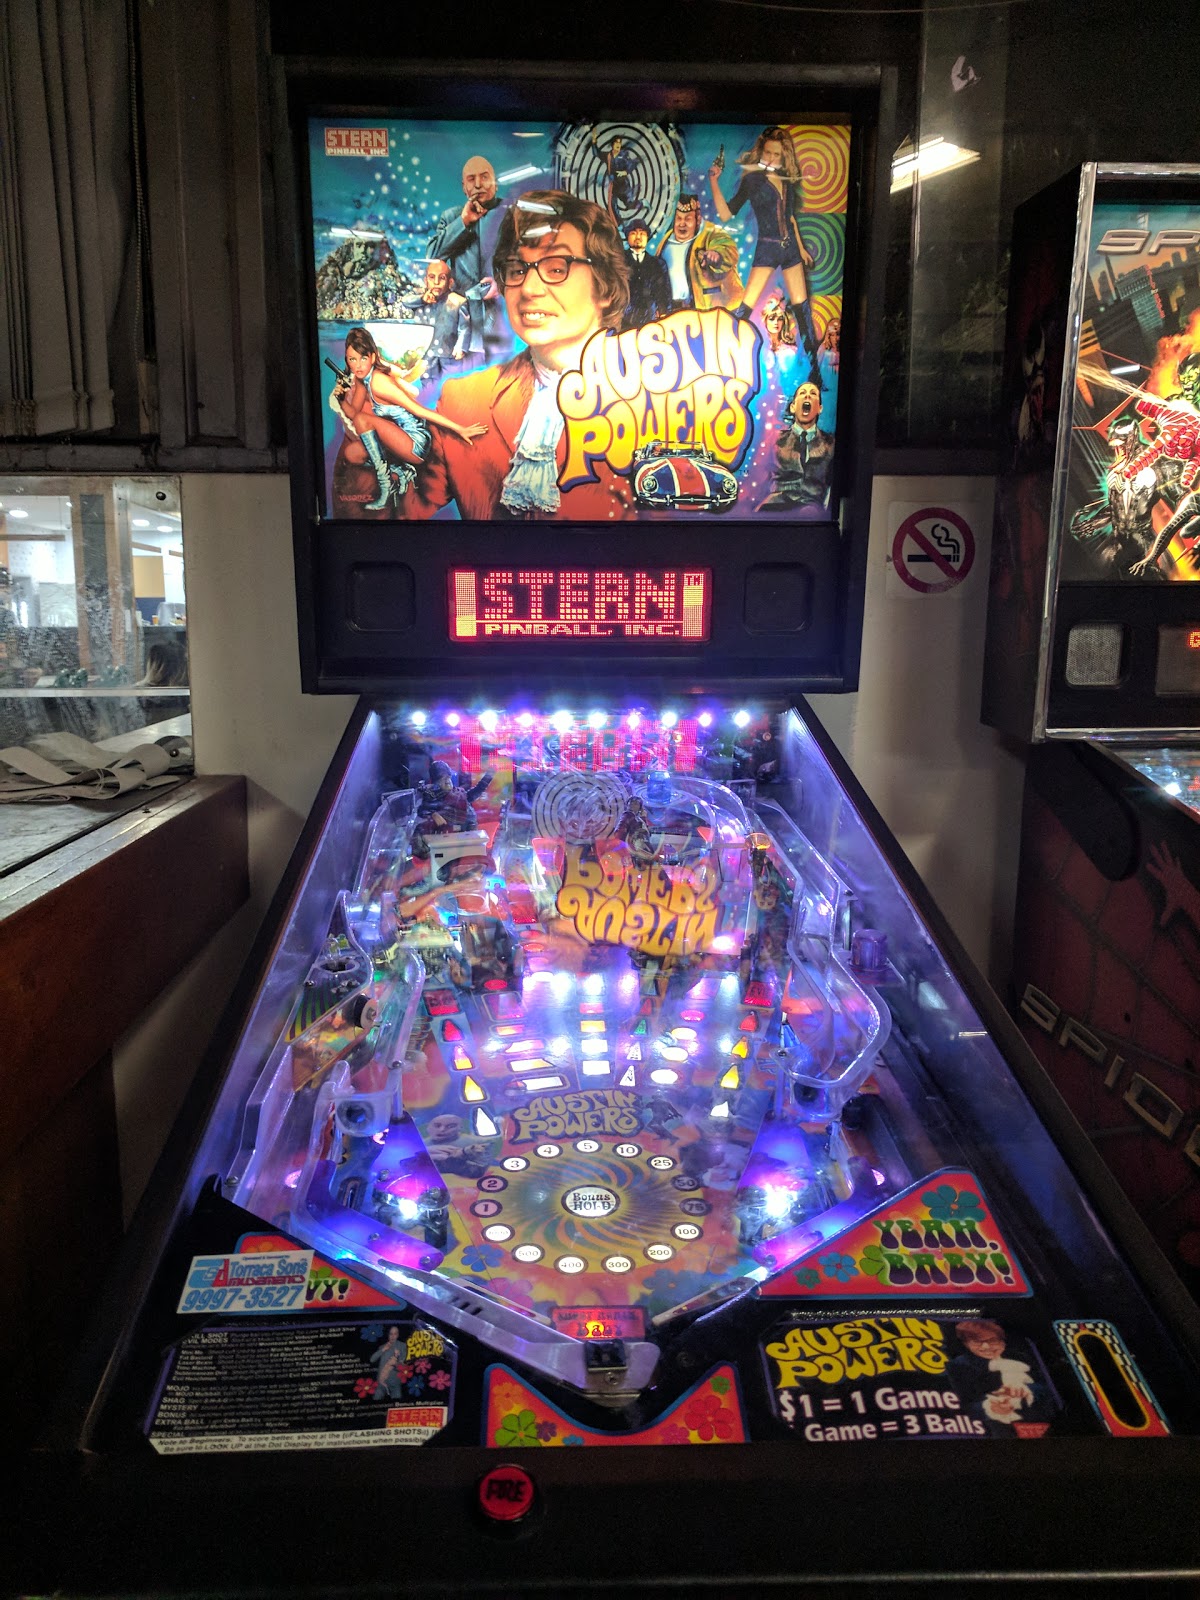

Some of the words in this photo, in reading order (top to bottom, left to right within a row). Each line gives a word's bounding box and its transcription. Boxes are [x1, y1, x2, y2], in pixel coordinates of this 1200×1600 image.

[326, 129, 387, 147] STERN
[557, 308, 758, 421] AUSTIN
[557, 374, 751, 488] POWERS
[484, 572, 676, 620] STERN
[625, 624, 680, 635] INC.
[512, 1089, 638, 1121] AUSTIN
[513, 1106, 641, 1142] POWERS
[543, 1146, 553, 1155] 4
[583, 1142, 593, 1150] 5
[619, 1146, 636, 1154] 10
[510, 1160, 520, 1168] 3
[653, 1159, 672, 1167] 25
[487, 1179, 498, 1188] 2
[482, 1203, 489, 1212] 1
[883, 1252, 1015, 1286] BABY!
[181, 1285, 304, 1312] 9997-3527
[765, 1316, 945, 1361] AUSTIN
[775, 1337, 949, 1390] POWERS
[388, 1408, 442, 1422] STERN
[779, 1390, 814, 1424] $1
[822, 1398, 843, 1412] =
[850, 1390, 867, 1415] 1
[874, 1386, 961, 1412] Game
[804, 1422, 877, 1443] Game
[903, 1414, 921, 1435] 3
[924, 1413, 986, 1437] Balls
[485, 1478, 526, 1502] FIRE
